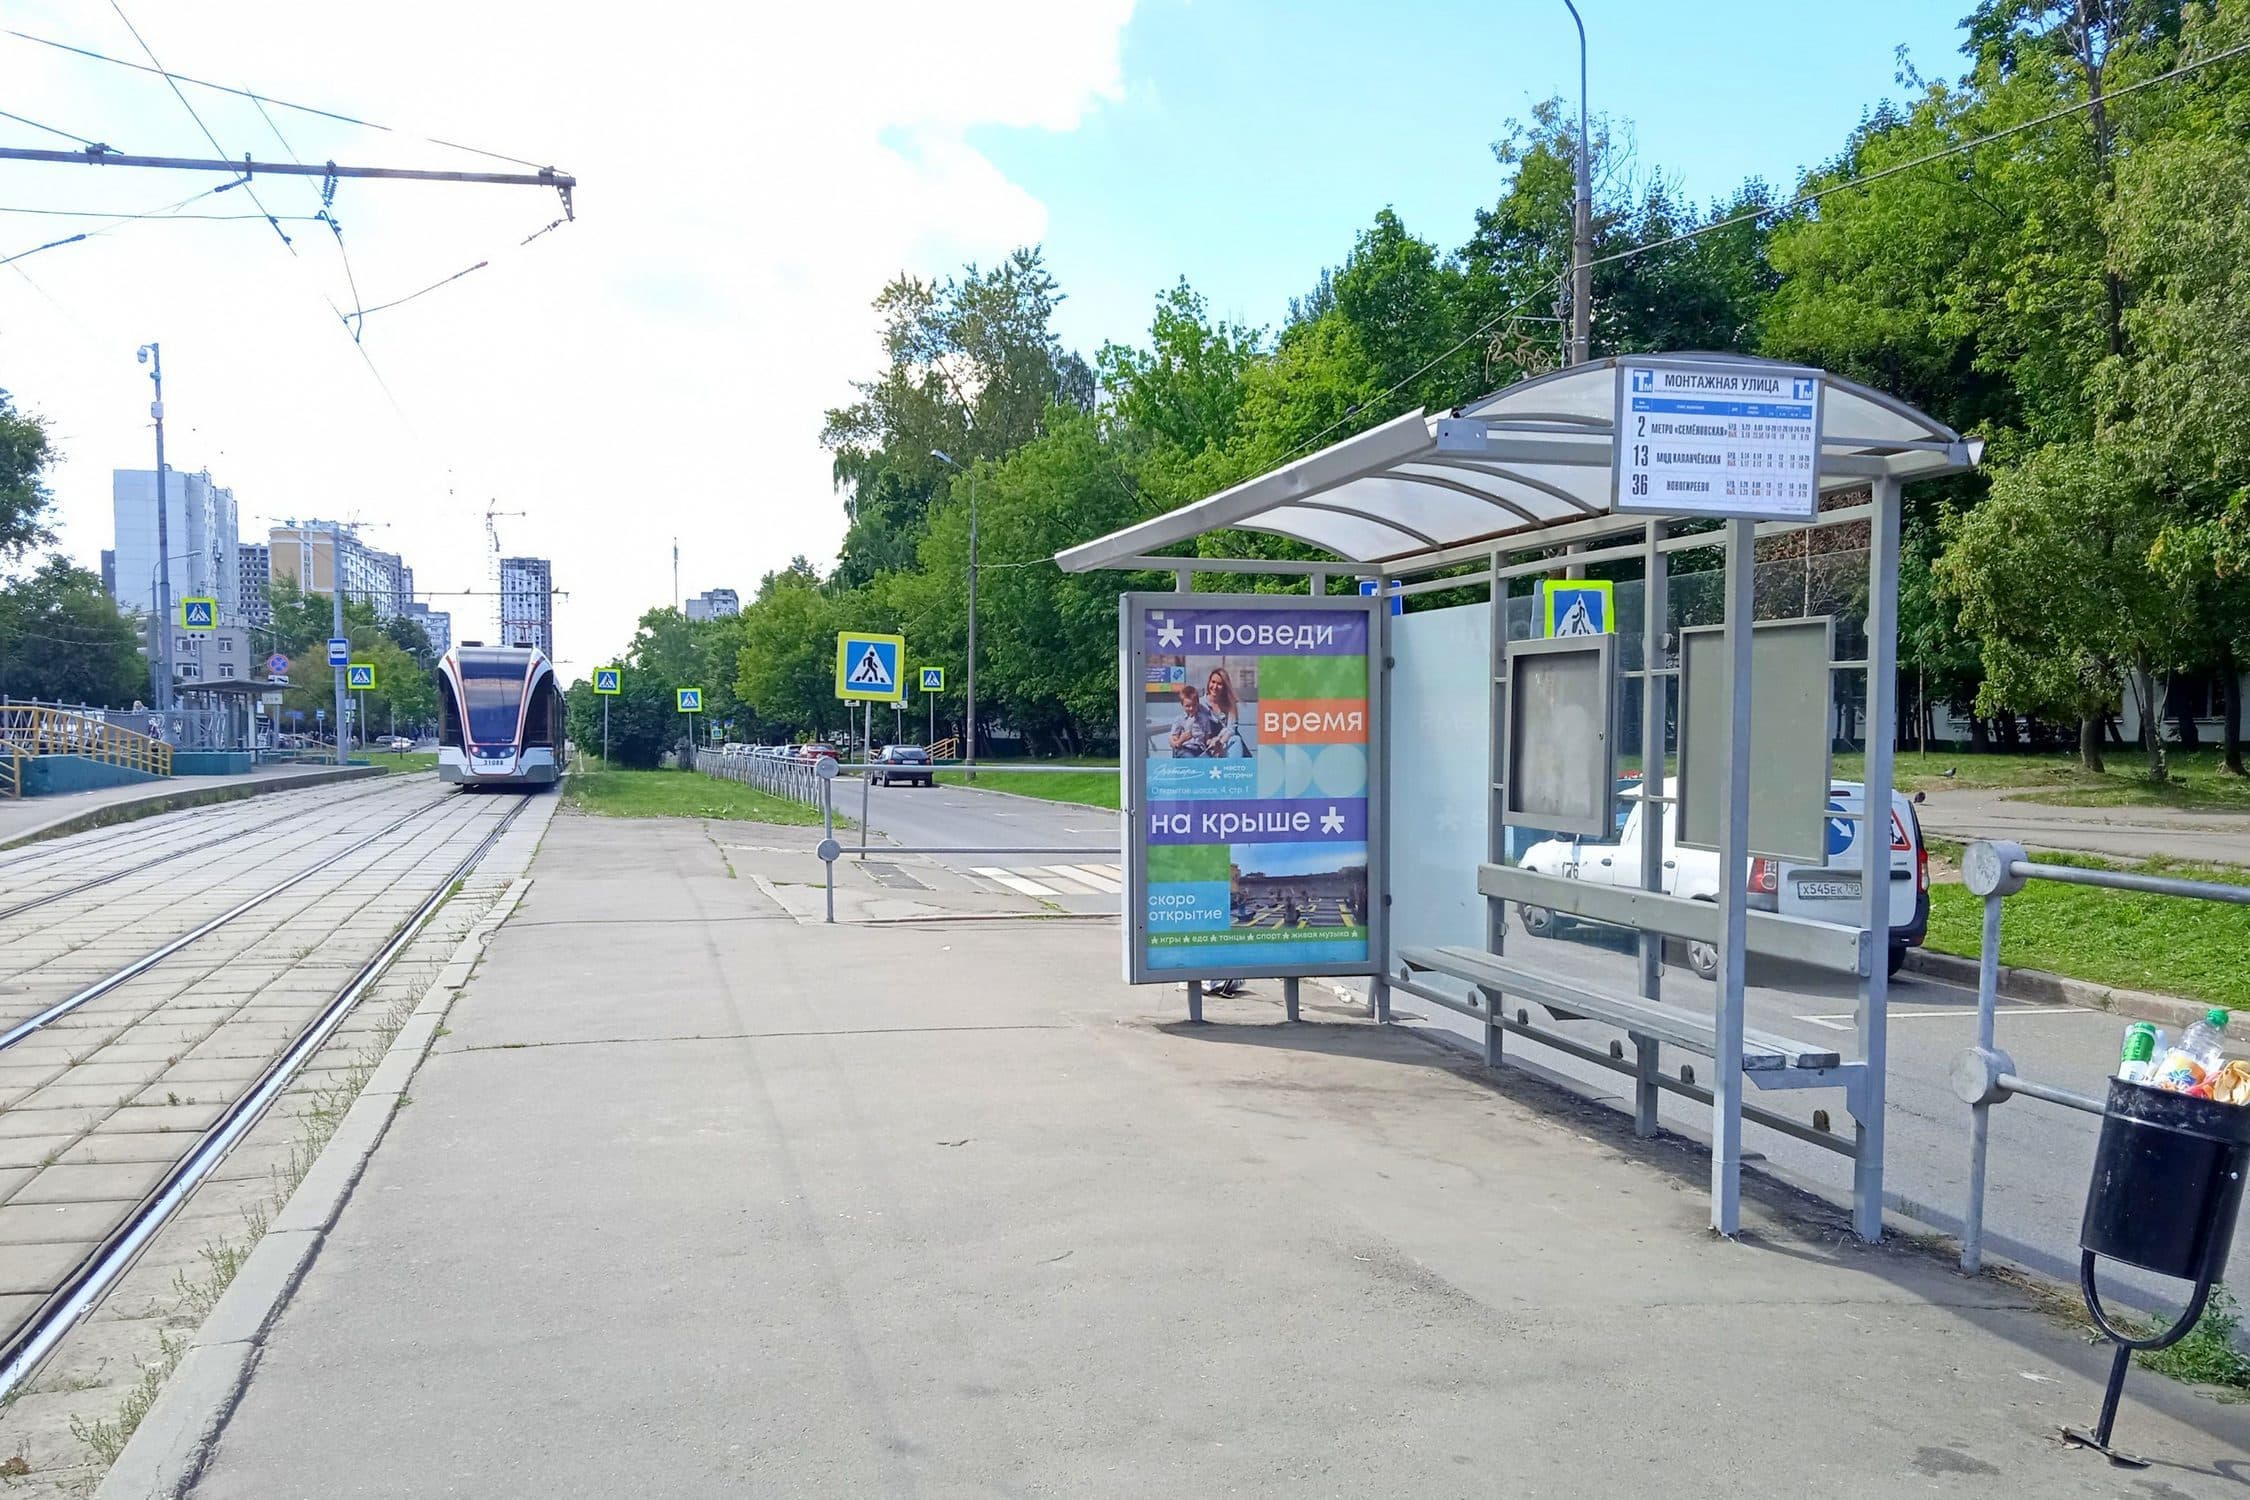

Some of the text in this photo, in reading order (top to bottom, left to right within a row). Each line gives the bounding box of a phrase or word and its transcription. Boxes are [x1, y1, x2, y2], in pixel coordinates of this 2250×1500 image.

[1665, 374, 1780, 393] МОНТАЖНАЯ УЛИЦА
[1637, 415, 1646, 437] 2
[1651, 423, 1673, 434] МЕТРО
[1633, 444, 1649, 466] 13
[1632, 473, 1648, 495] 36
[1194, 624, 1333, 650] проведи
[1264, 711, 1363, 737] время
[1223, 772, 1253, 780] встречи
[1151, 811, 1311, 839] на крыше
[1148, 894, 1195, 909] скоро
[1148, 909, 1223, 923] открытие
[1159, 936, 1182, 944] игры
[1256, 932, 1281, 940] спорт
[1319, 930, 1350, 938] музыка
